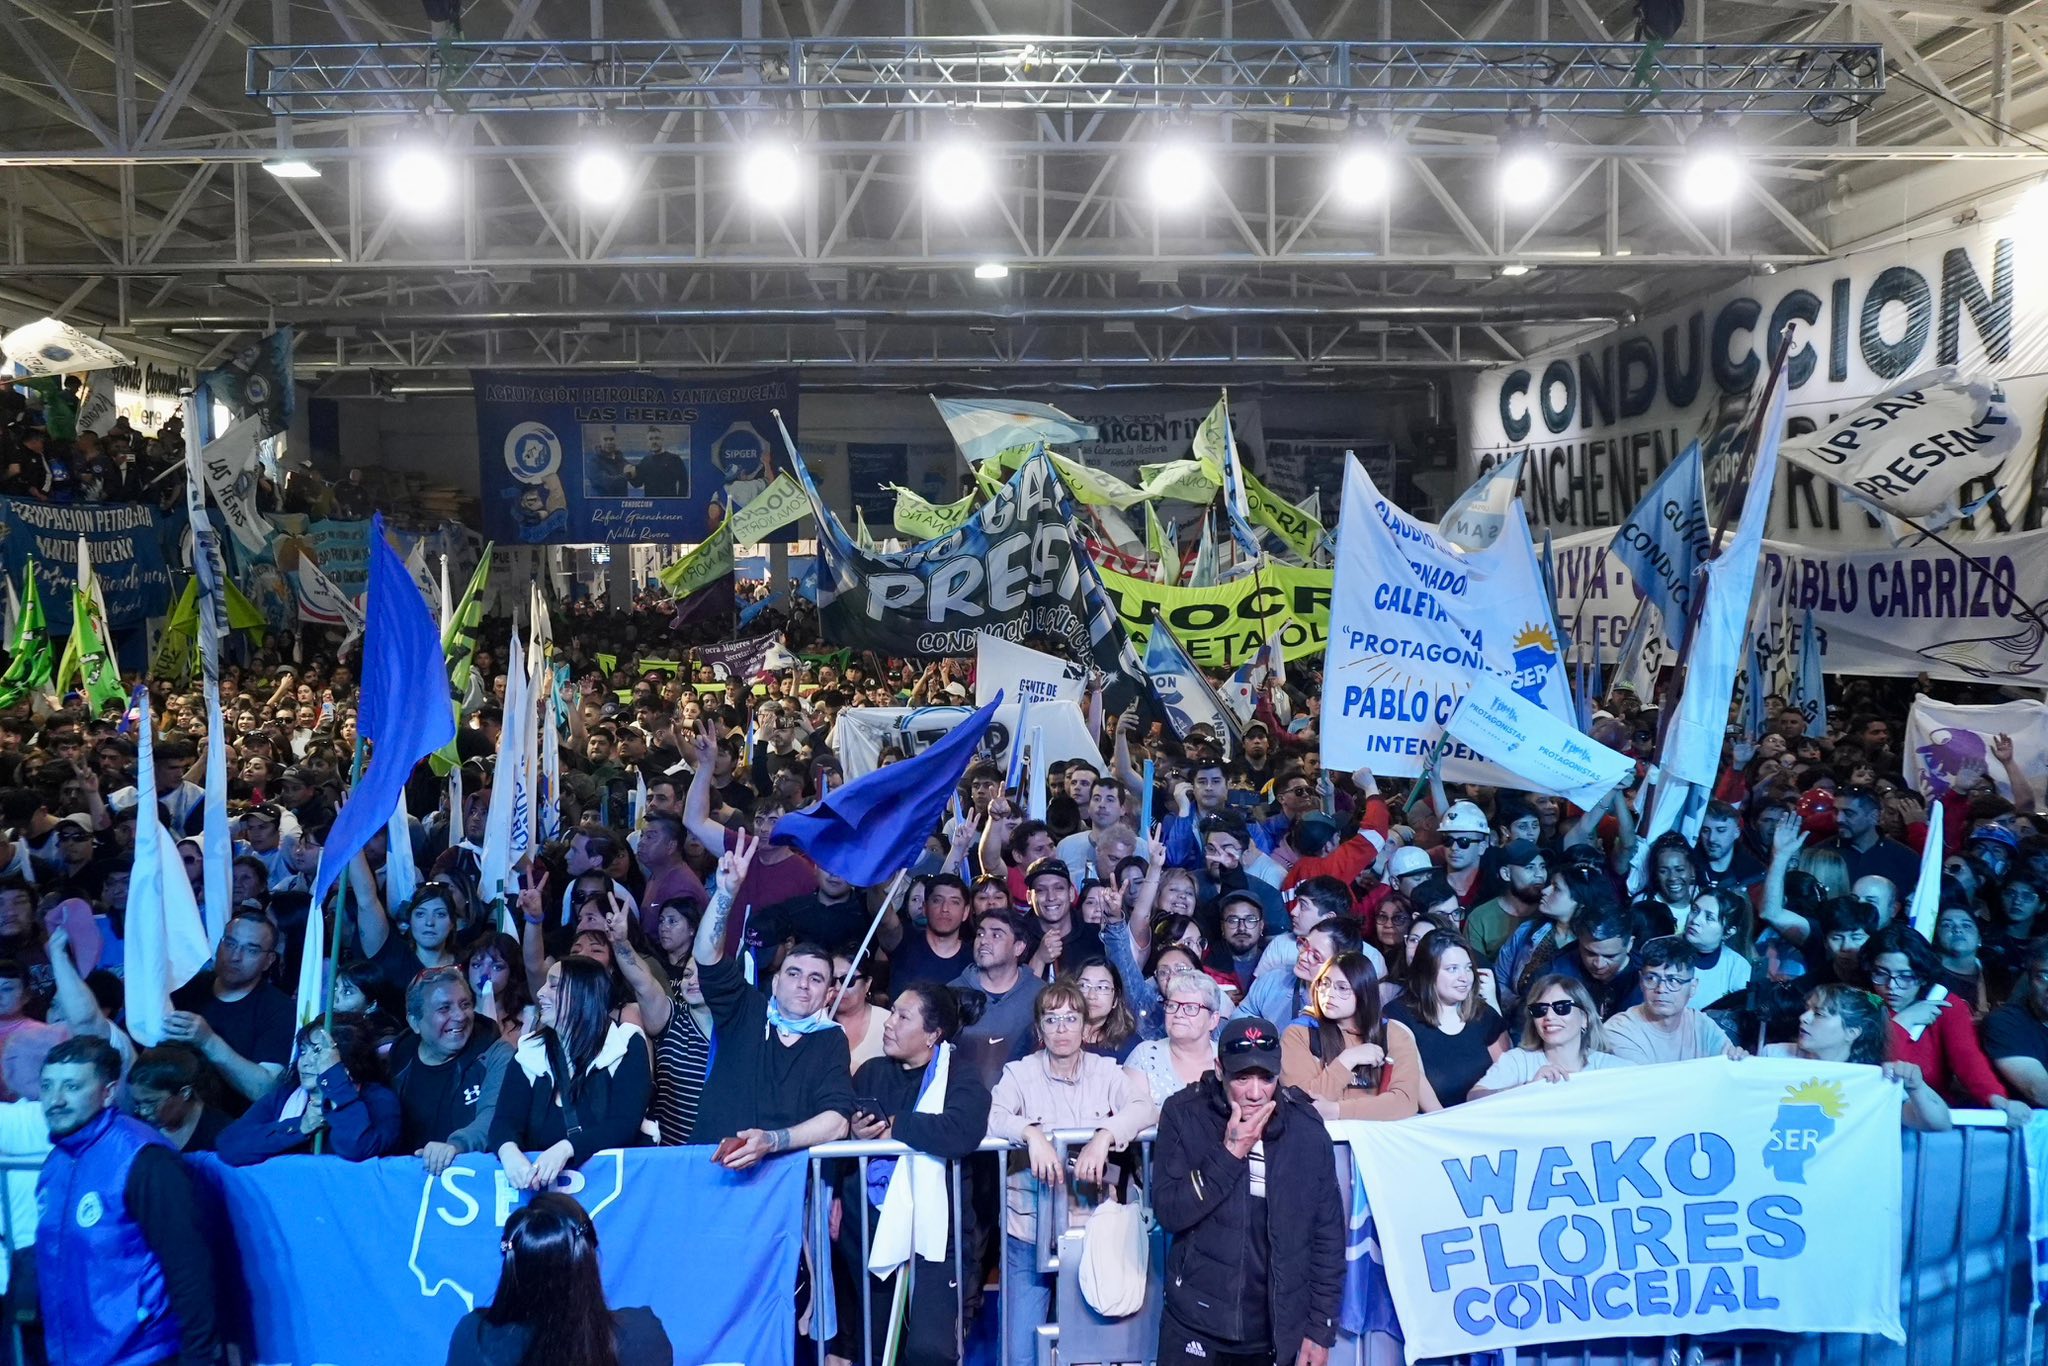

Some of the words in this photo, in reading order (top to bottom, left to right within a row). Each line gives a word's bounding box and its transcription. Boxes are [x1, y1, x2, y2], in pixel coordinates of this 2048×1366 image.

[1500, 239, 2014, 442] CONDUCCION
[582, 386, 665, 403] PETROLERA
[575, 406, 617, 421] LAS
[625, 407, 699, 422] HERAS
[207, 458, 232, 481] LAS
[725, 449, 757, 459] SIPGER
[218, 484, 247, 528] HERAS
[1867, 555, 2016, 618] CARRIZO
[1105, 586, 1333, 631] UOCR
[1046, 683, 1058, 697] DE
[1511, 663, 1549, 689] SER
[1342, 685, 1428, 722] PABLO
[1469, 702, 1527, 742] PROTAGONISTAS
[1366, 734, 1494, 763] INTENDEN
[1538, 746, 1601, 781] PROTAGONISTAS
[1770, 1127, 1819, 1153] SER
[1442, 1131, 1737, 1218] WAKO
[1421, 1194, 1807, 1293] FLORES
[1453, 1266, 1780, 1336] CONCEJAL
